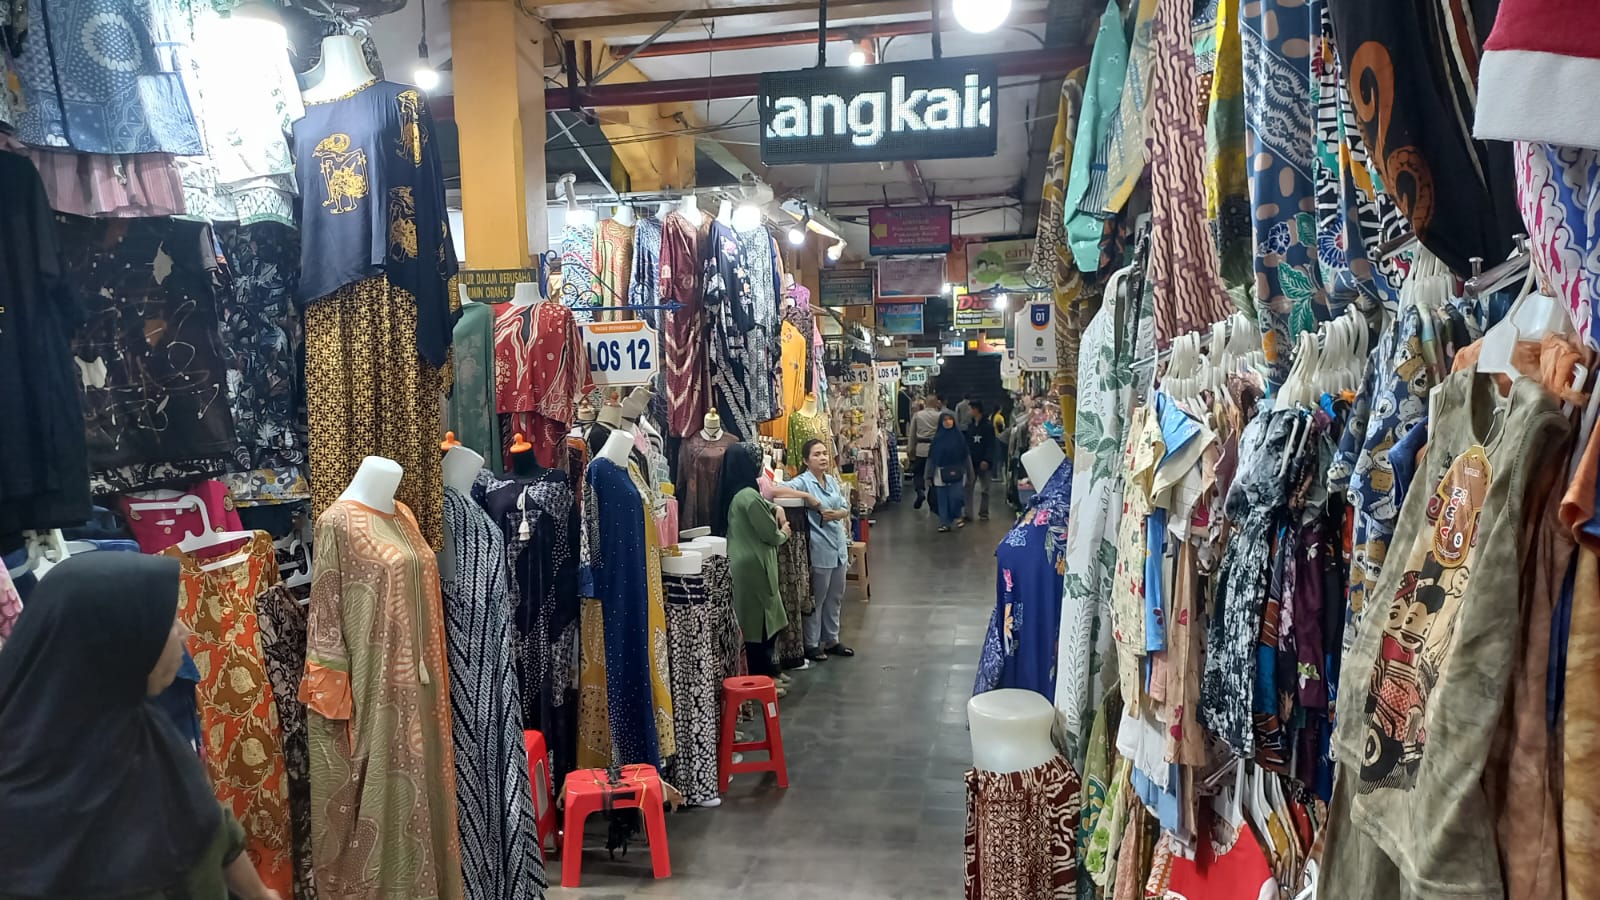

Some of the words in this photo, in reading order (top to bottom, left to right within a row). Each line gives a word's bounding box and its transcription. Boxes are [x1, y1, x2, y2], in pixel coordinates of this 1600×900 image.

[476, 273, 498, 284] DALAM
[485, 286, 508, 298] ORANG
[1036, 312, 1045, 322] 01
[587, 340, 621, 371] LOS
[626, 338, 651, 370] 12
[858, 370, 868, 382] 13
[878, 369, 889, 378] LOS
[890, 367, 899, 377] 14
